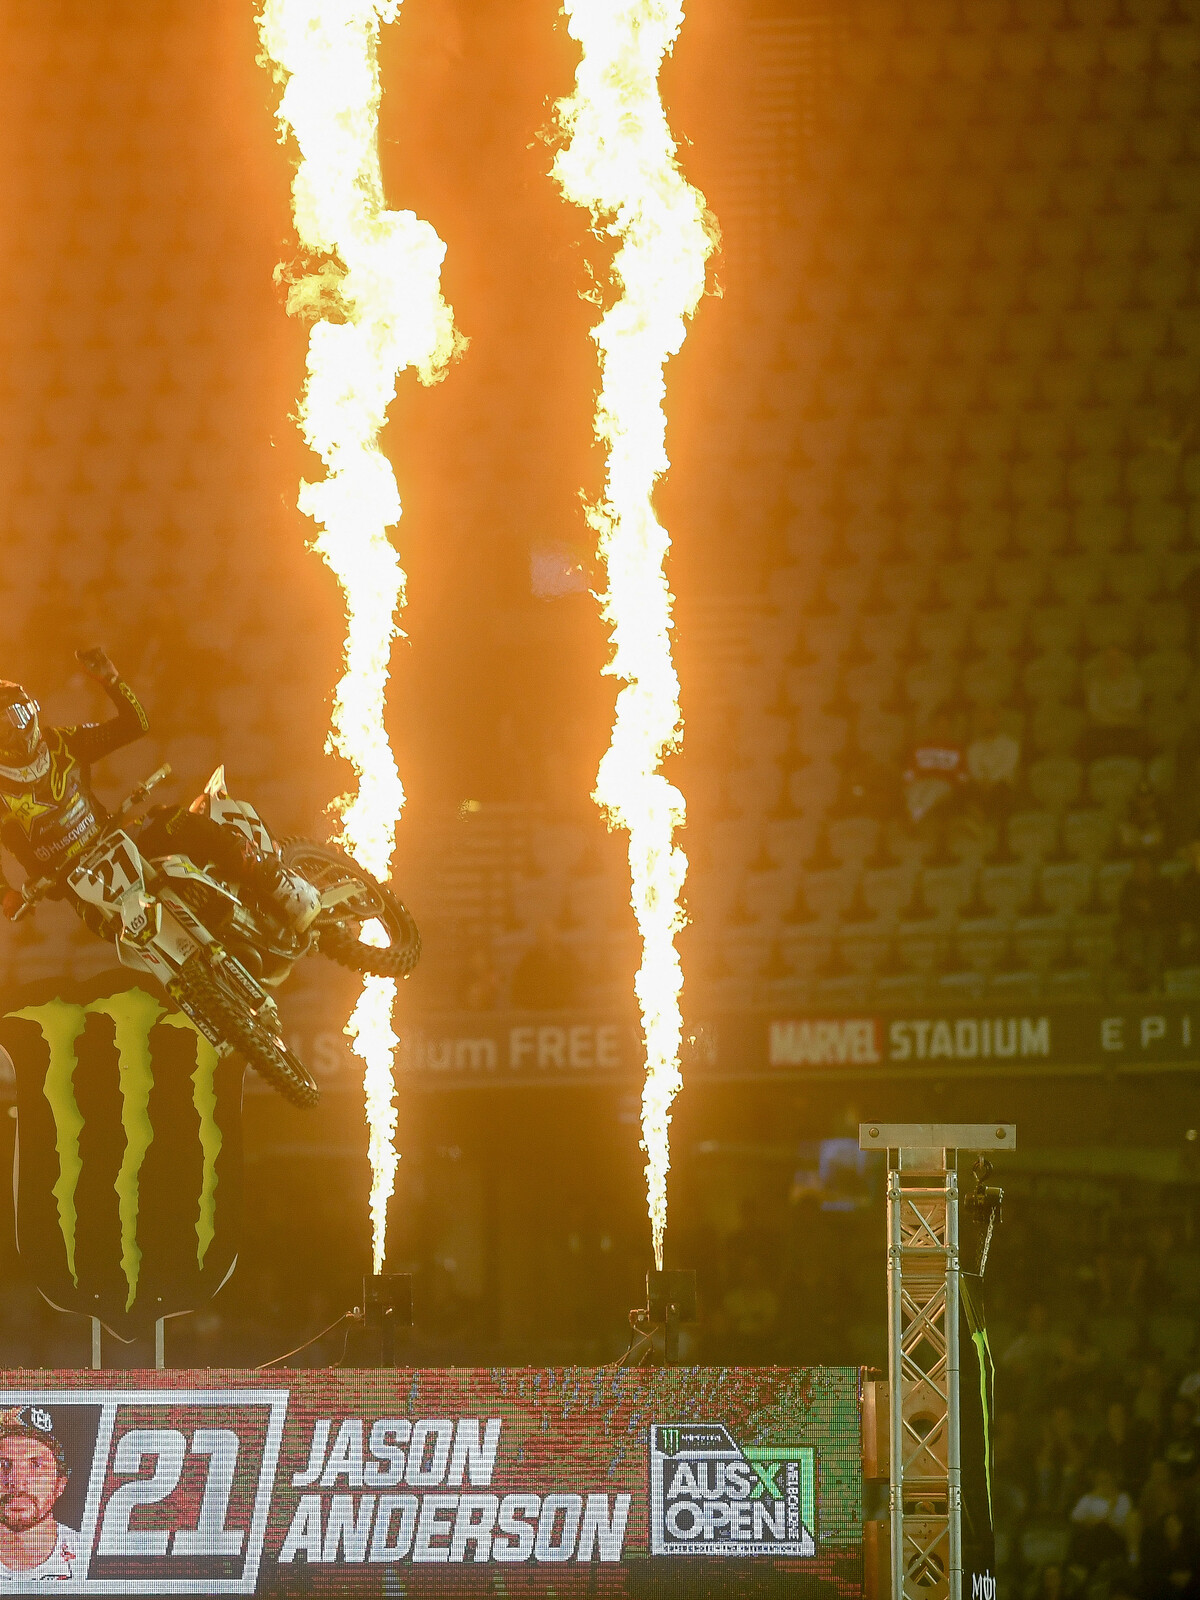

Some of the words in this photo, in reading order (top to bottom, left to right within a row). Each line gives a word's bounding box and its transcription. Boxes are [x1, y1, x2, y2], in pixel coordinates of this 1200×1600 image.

[87, 843, 141, 903] 21
[224, 960, 262, 999] DUNLOP
[509, 1025, 620, 1070] FREE
[770, 1020, 879, 1064] MARVEL
[890, 1018, 1050, 1059] STADIUM
[292, 1418, 501, 1487] JASON
[97, 1429, 243, 1556] 21
[666, 1462, 785, 1500] AUS-X
[278, 1493, 632, 1563] ANDERSON
[665, 1500, 786, 1540] OPEN
